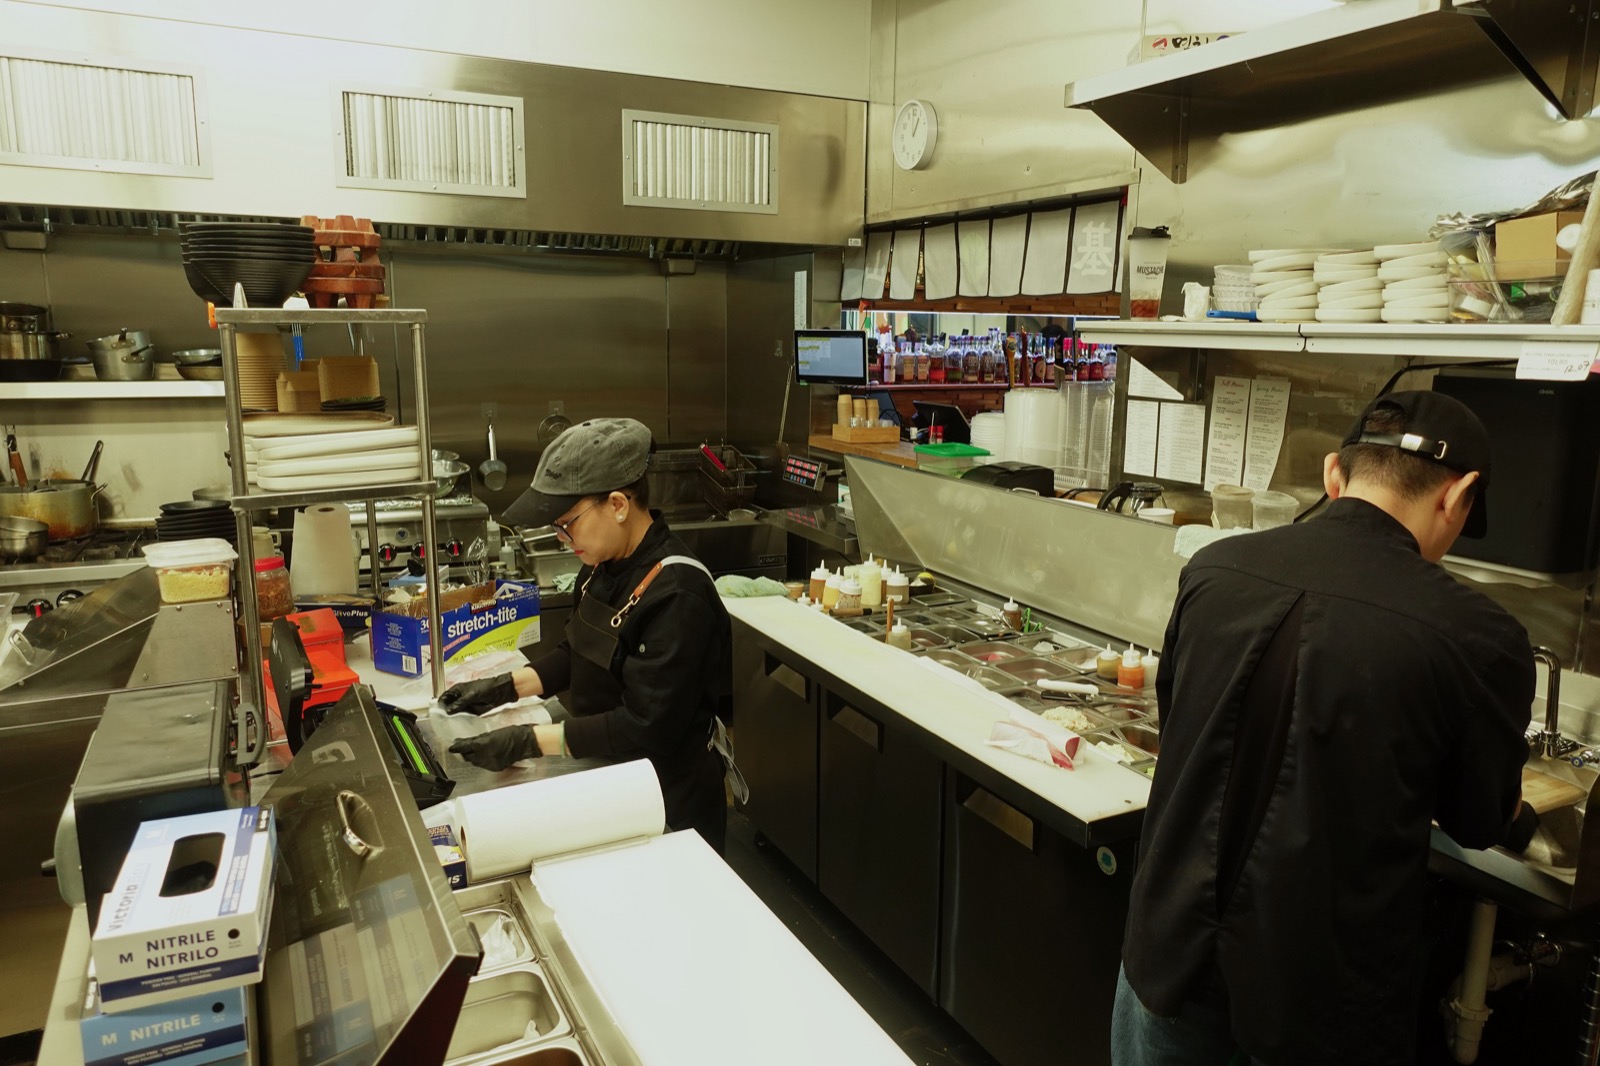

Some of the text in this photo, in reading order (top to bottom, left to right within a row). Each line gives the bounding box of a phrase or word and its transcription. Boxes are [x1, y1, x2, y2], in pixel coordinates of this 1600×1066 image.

[447, 606, 517, 638] stretch-tite
[146, 930, 216, 952] NITRILE
[118, 952, 134, 964] M
[146, 946, 219, 969] NITRILO
[130, 1013, 201, 1042] NITRILE
[102, 1032, 118, 1046] M
